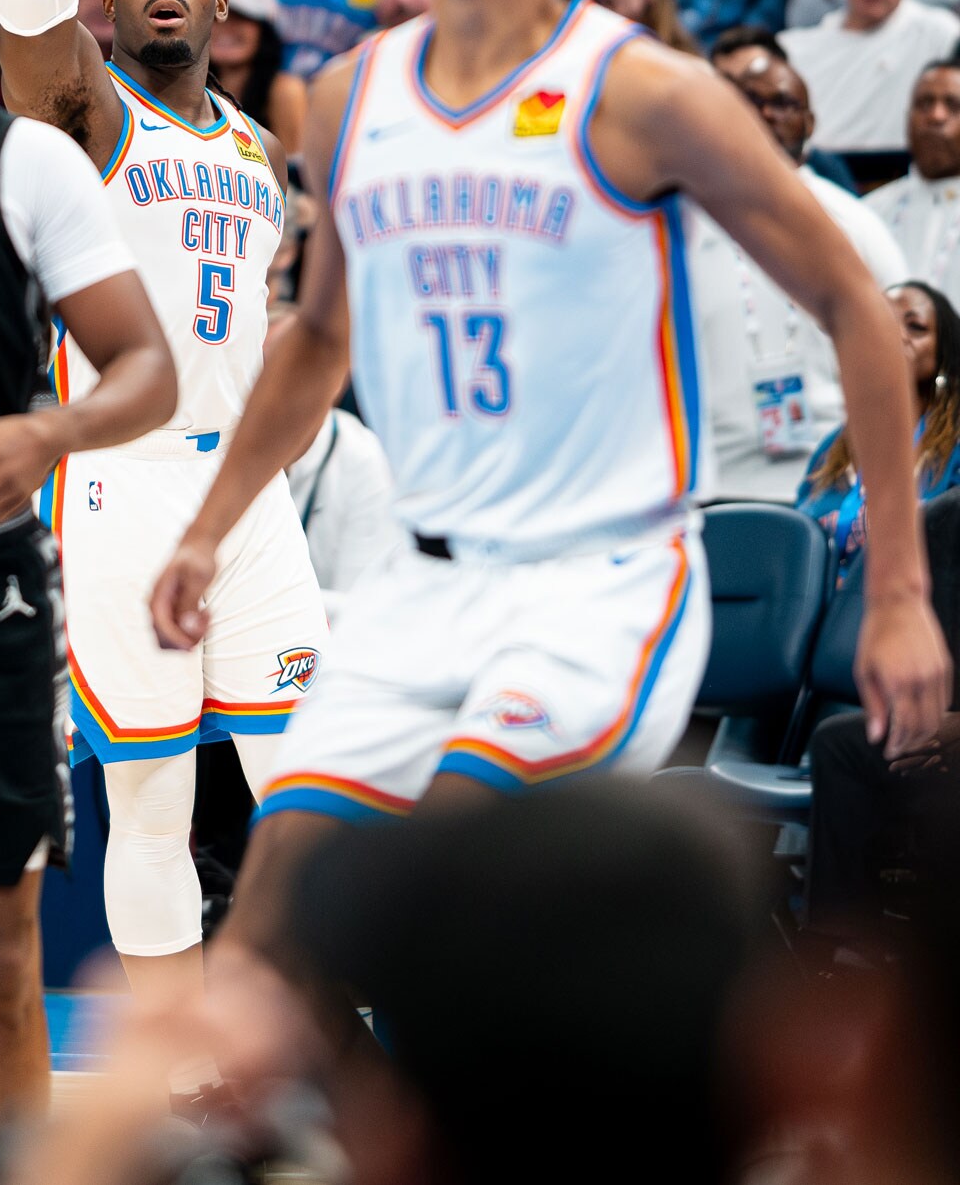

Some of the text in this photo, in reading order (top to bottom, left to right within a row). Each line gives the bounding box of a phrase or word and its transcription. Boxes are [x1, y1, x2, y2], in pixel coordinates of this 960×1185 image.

[125, 159, 285, 235] OKLAHOMA
[182, 208, 251, 259] CITY
[192, 259, 235, 345] 5
[407, 242, 502, 298] CITY
[418, 308, 513, 420] 13
[277, 655, 315, 686] OKC
